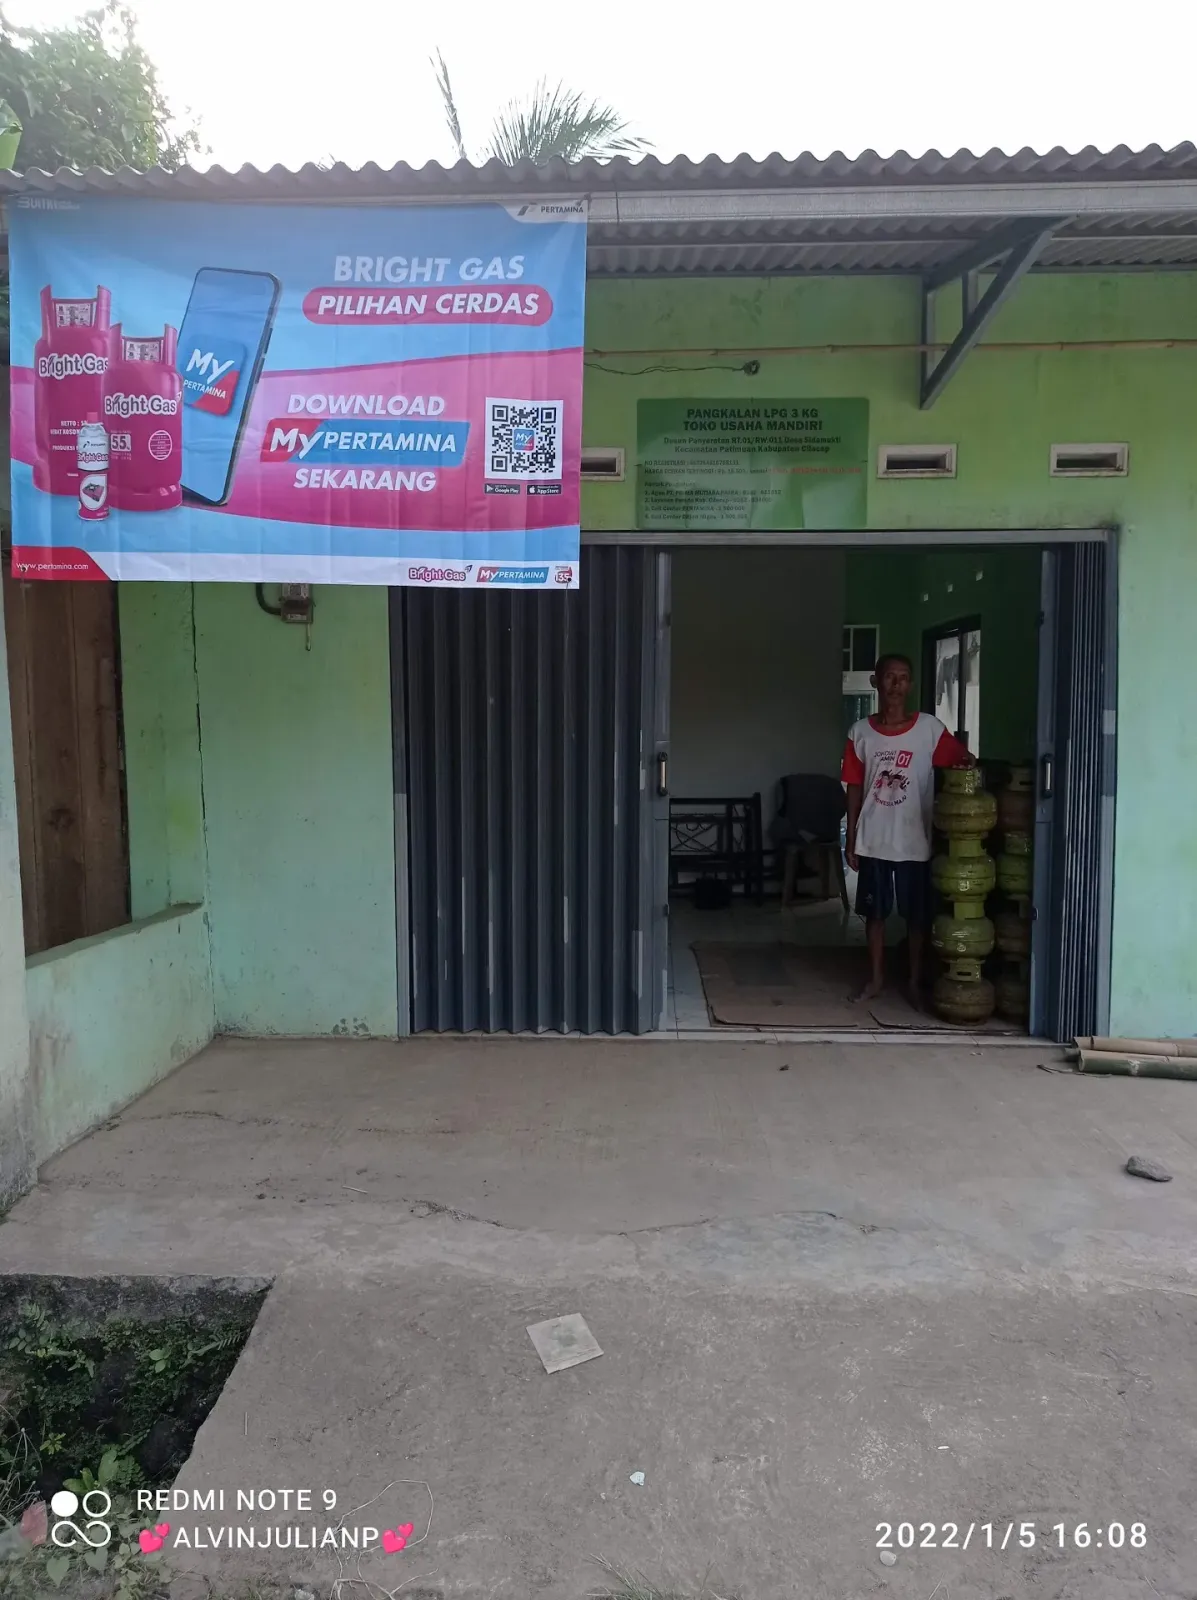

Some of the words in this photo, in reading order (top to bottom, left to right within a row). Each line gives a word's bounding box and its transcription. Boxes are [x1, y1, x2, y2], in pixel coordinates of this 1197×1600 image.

[540, 205, 584, 213] PERTAMINA
[334, 255, 451, 283] BRIGHT
[459, 254, 525, 281] GAS
[317, 294, 427, 316] PILIHAN
[435, 292, 540, 316] CERDAS
[39, 353, 82, 379] Bright
[186, 348, 235, 385] My
[183, 379, 227, 399] PERTAMINA
[105, 393, 147, 417] Bright
[149, 396, 177, 414] Gas
[287, 394, 445, 416] DOWNLOAD
[686, 408, 761, 419] PANGKALAN
[763, 408, 788, 418] LPG
[791, 408, 799, 418] 3
[801, 408, 819, 418] KG
[683, 421, 717, 431] TOKO
[720, 421, 763, 431] USAHA
[766, 420, 823, 431] MANDIRI
[804, 435, 841, 443] Sidamukti
[758, 445, 800, 454] Kabupaten
[801, 445, 830, 454] Cilacap
[293, 468, 437, 492] SEKARANG
[408, 566, 443, 582] Bright
[444, 568, 466, 582] Gas
[555, 571, 570, 581] 135
[897, 753, 911, 766] 01
